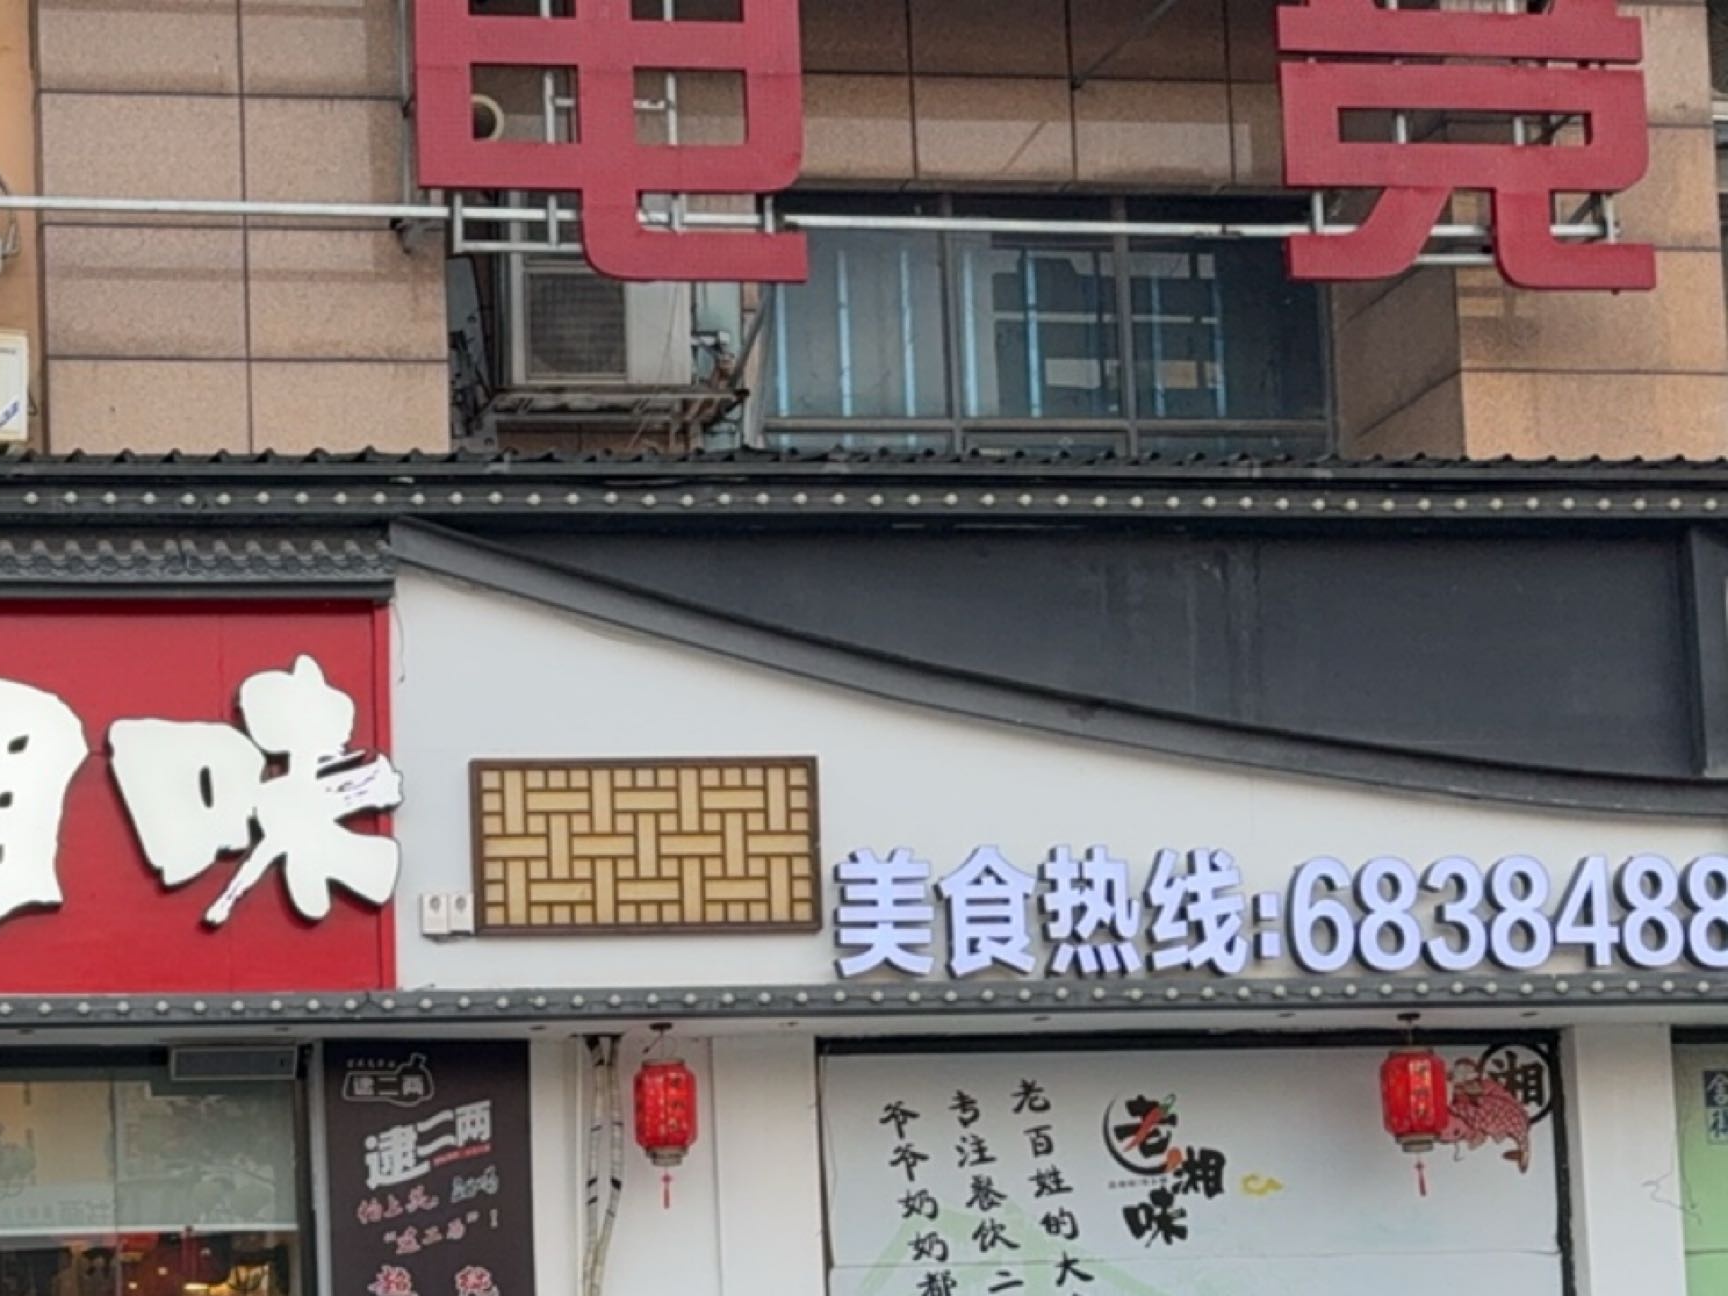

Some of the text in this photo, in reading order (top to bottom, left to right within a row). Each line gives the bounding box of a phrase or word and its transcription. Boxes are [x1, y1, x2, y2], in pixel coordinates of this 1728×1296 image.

[364, 1100, 491, 1189] 逮二两
[1113, 1094, 1227, 1247] 老湘味
